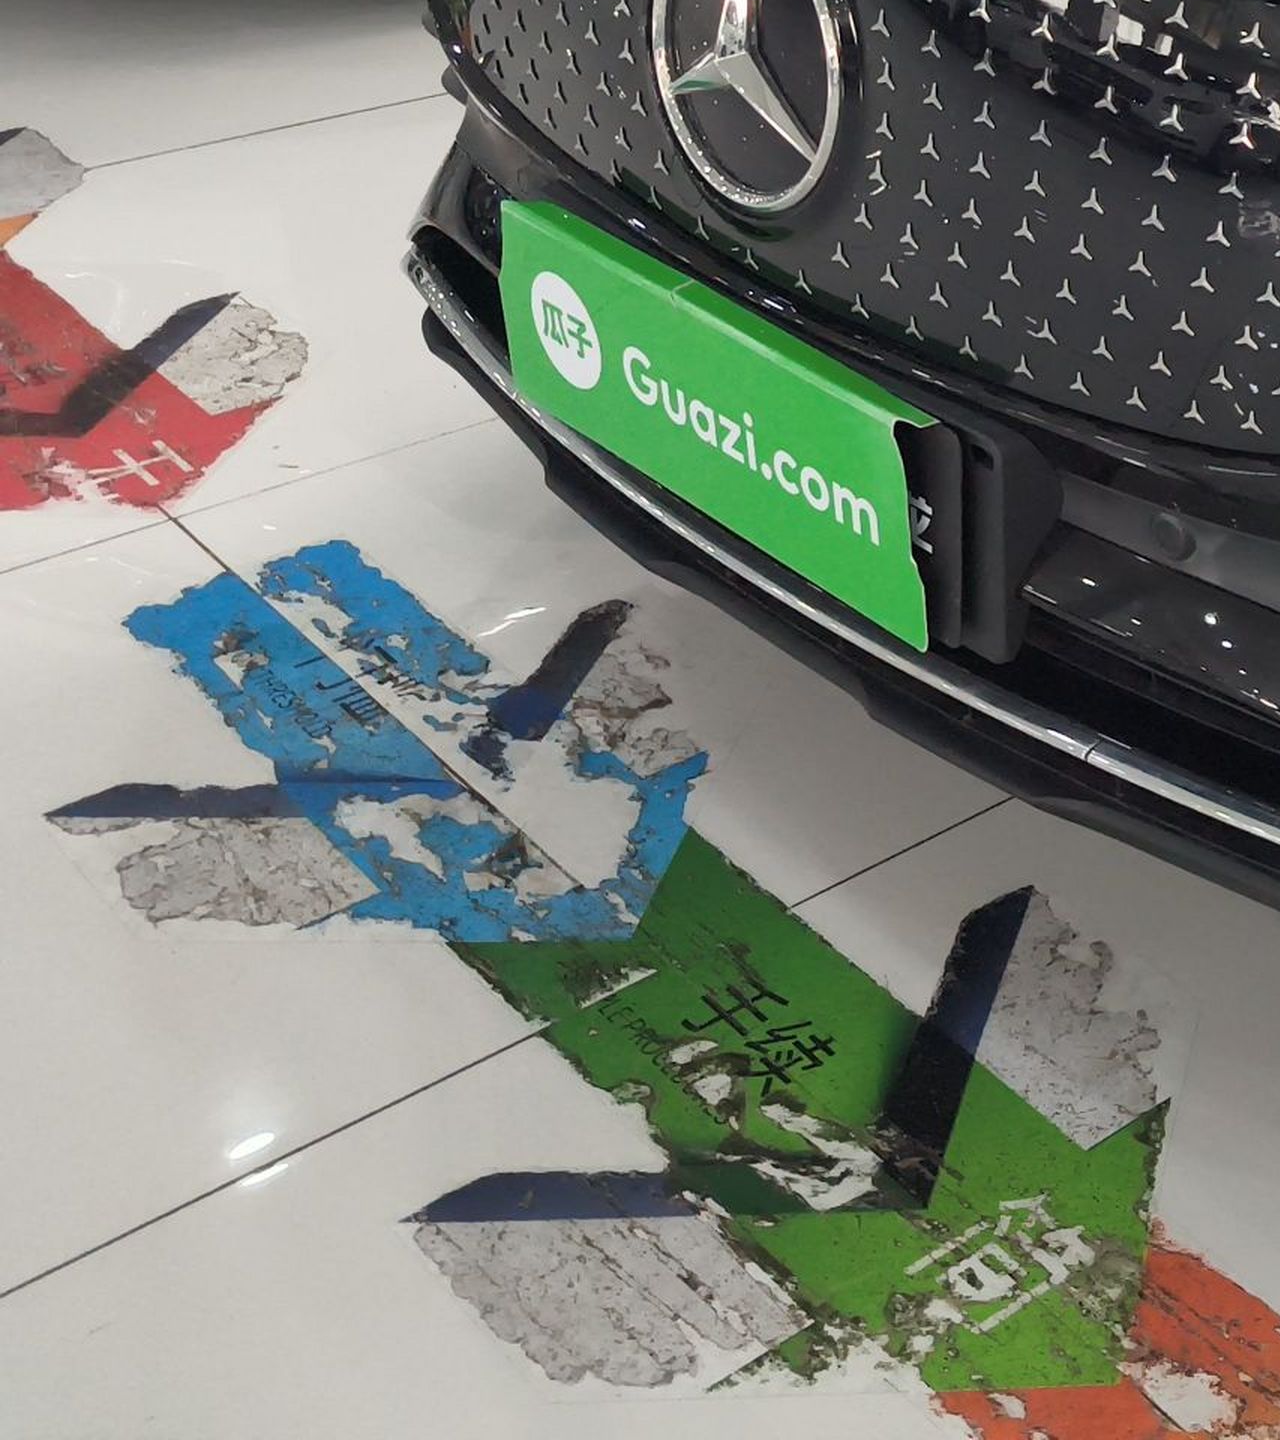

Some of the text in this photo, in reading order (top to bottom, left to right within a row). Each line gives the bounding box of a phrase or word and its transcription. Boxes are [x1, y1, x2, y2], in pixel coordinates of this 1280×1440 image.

[541, 298, 594, 359] 瓜子
[623, 345, 880, 547] Guazi.com
[681, 968, 836, 1097] 手续
